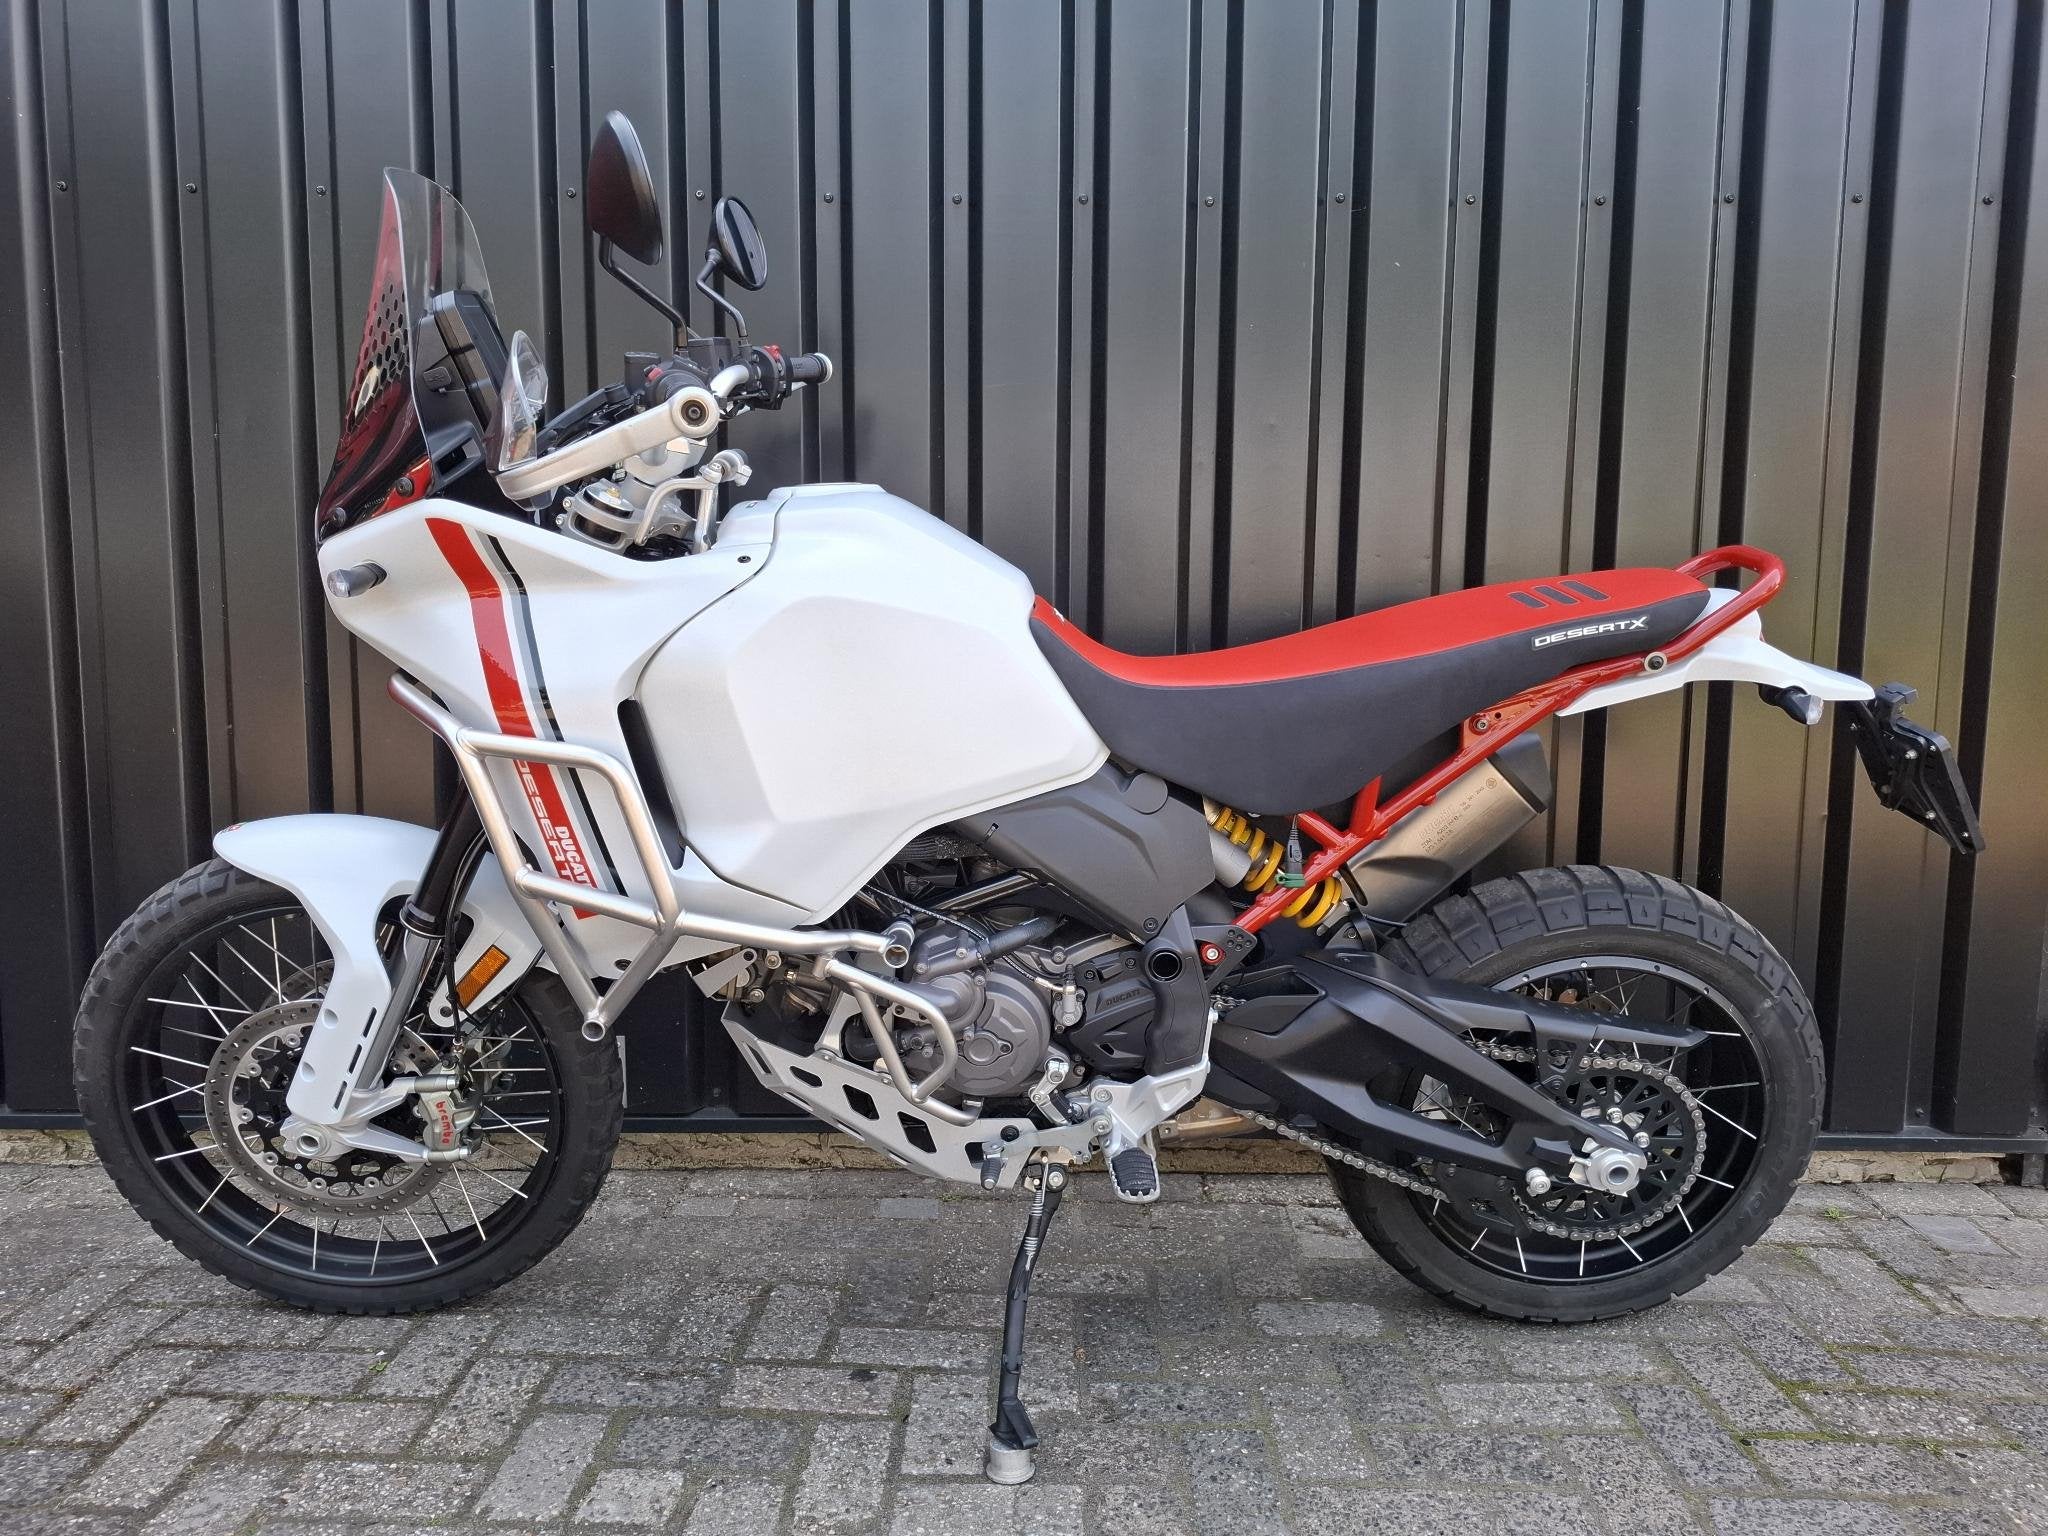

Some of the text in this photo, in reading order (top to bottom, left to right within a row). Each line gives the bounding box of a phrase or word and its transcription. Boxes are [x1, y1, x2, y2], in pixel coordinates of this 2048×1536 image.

[1534, 616, 1648, 647] DESERTX
[554, 826, 592, 886] DUCAT
[1105, 989, 1141, 1006] DUCATI
[436, 1101, 454, 1144] brembo
